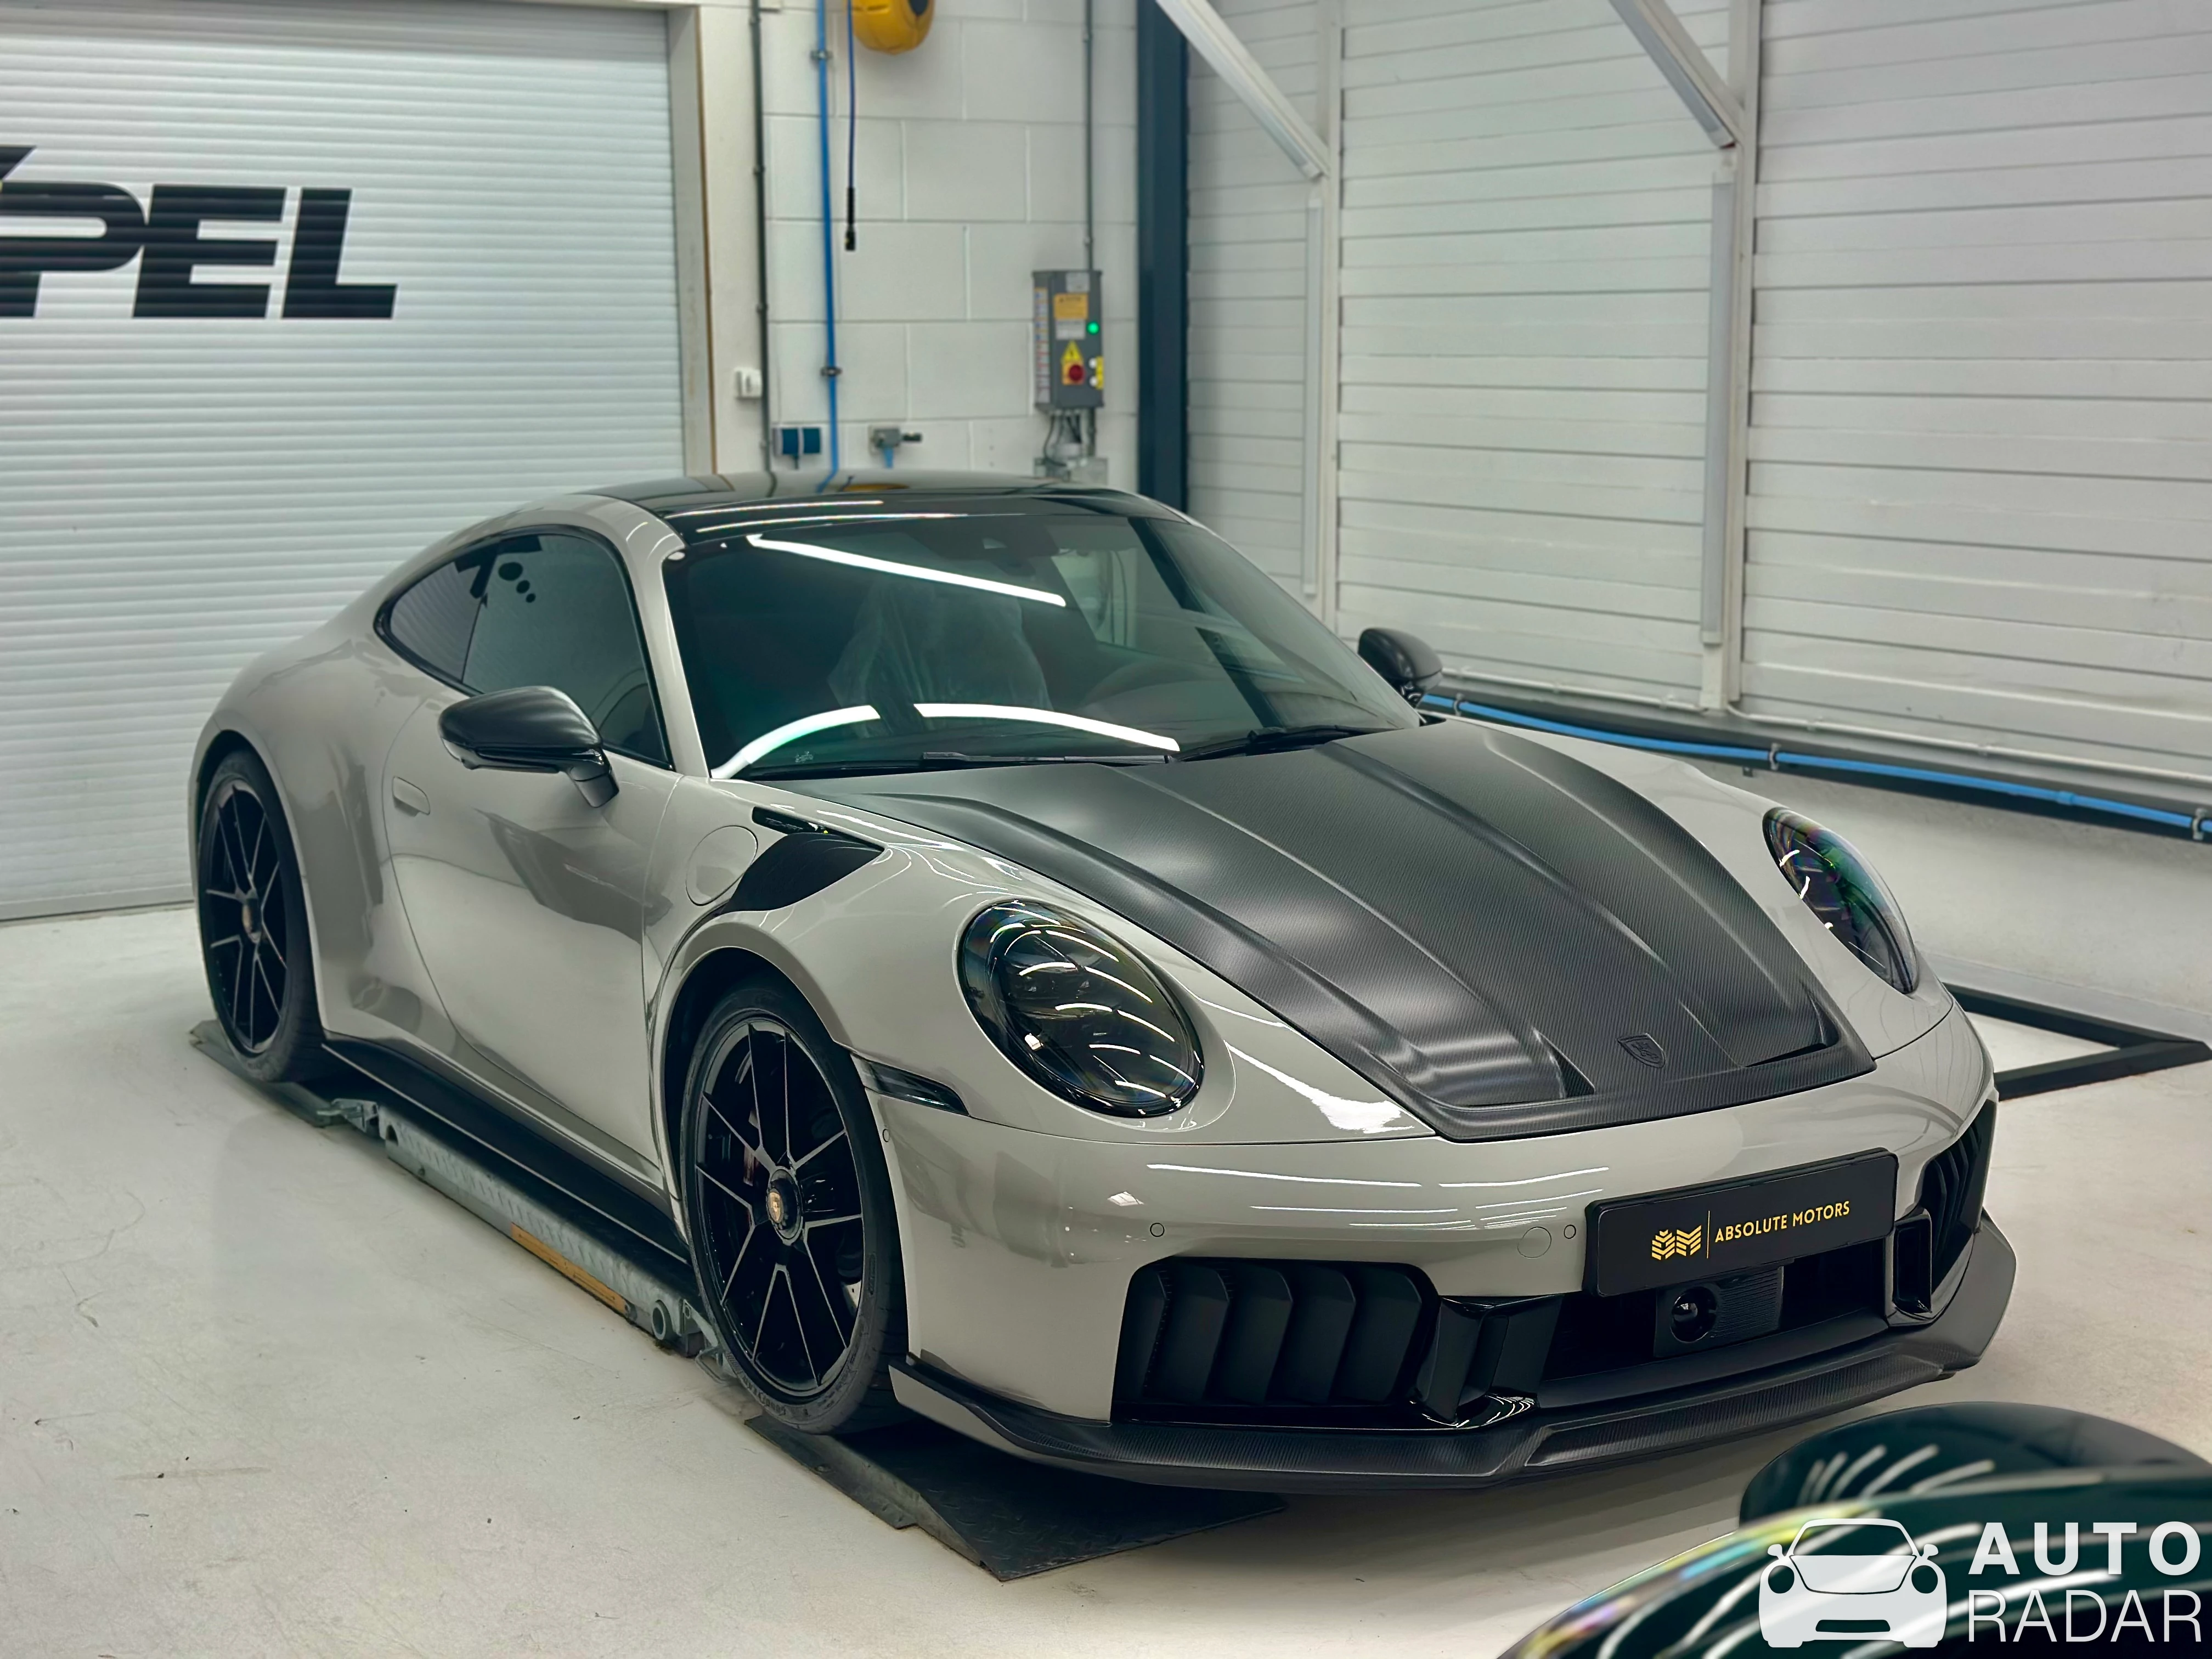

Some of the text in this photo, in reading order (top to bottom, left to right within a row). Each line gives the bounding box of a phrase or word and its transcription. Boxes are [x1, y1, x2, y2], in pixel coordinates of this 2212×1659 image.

[0, 146, 397, 319] PEL
[1715, 1215, 1787, 1243] ABSOLUTE
[1792, 1201, 1850, 1226] MOTORS
